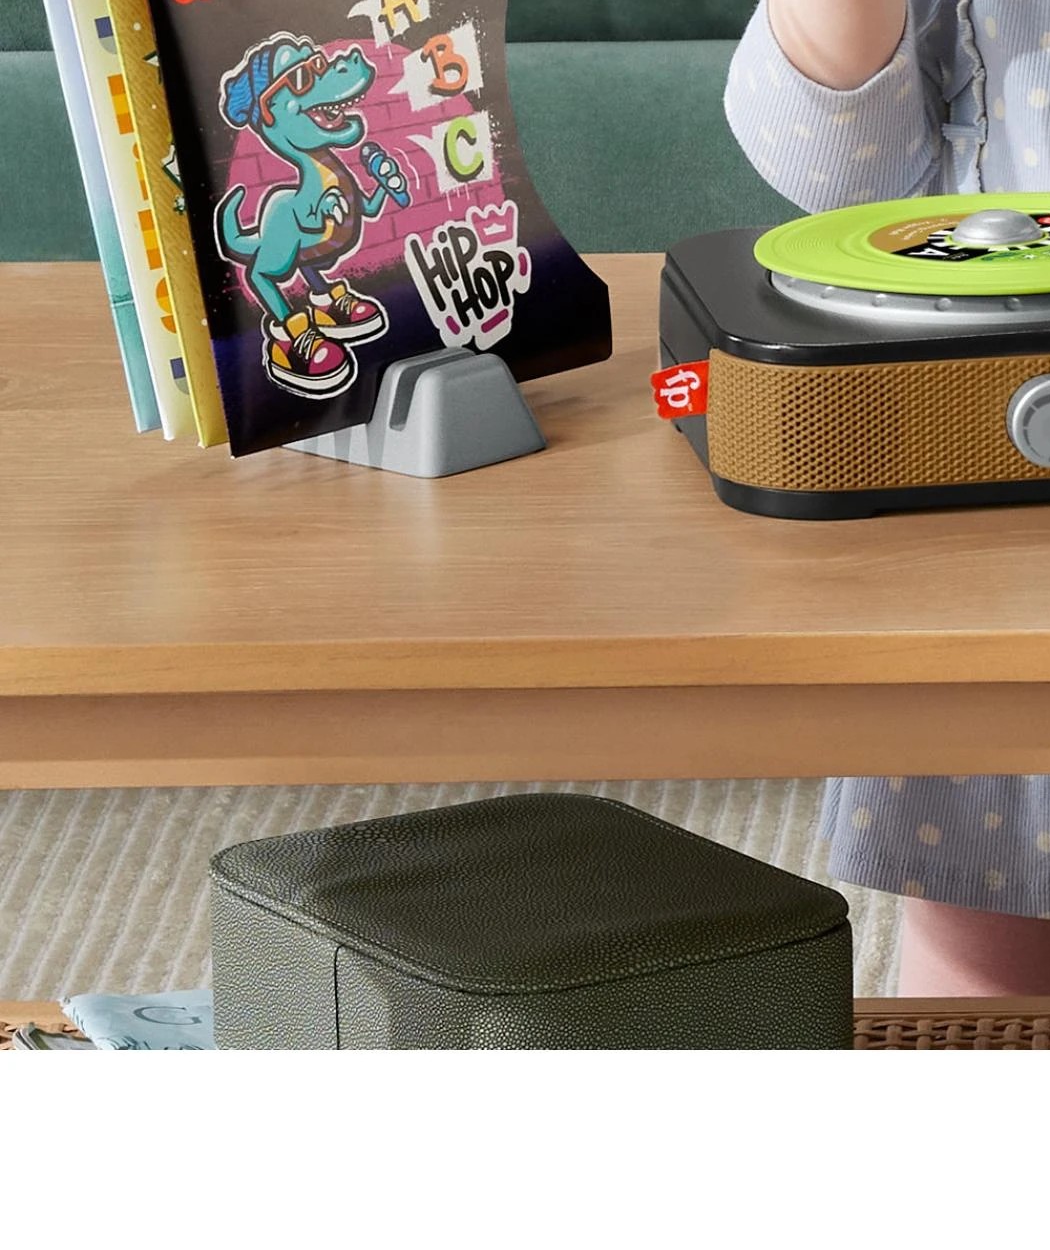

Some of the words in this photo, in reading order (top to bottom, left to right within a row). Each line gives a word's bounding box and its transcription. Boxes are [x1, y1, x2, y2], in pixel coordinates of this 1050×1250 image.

[421, 34, 469, 95] B
[444, 116, 484, 182] C
[660, 369, 701, 408] fp
